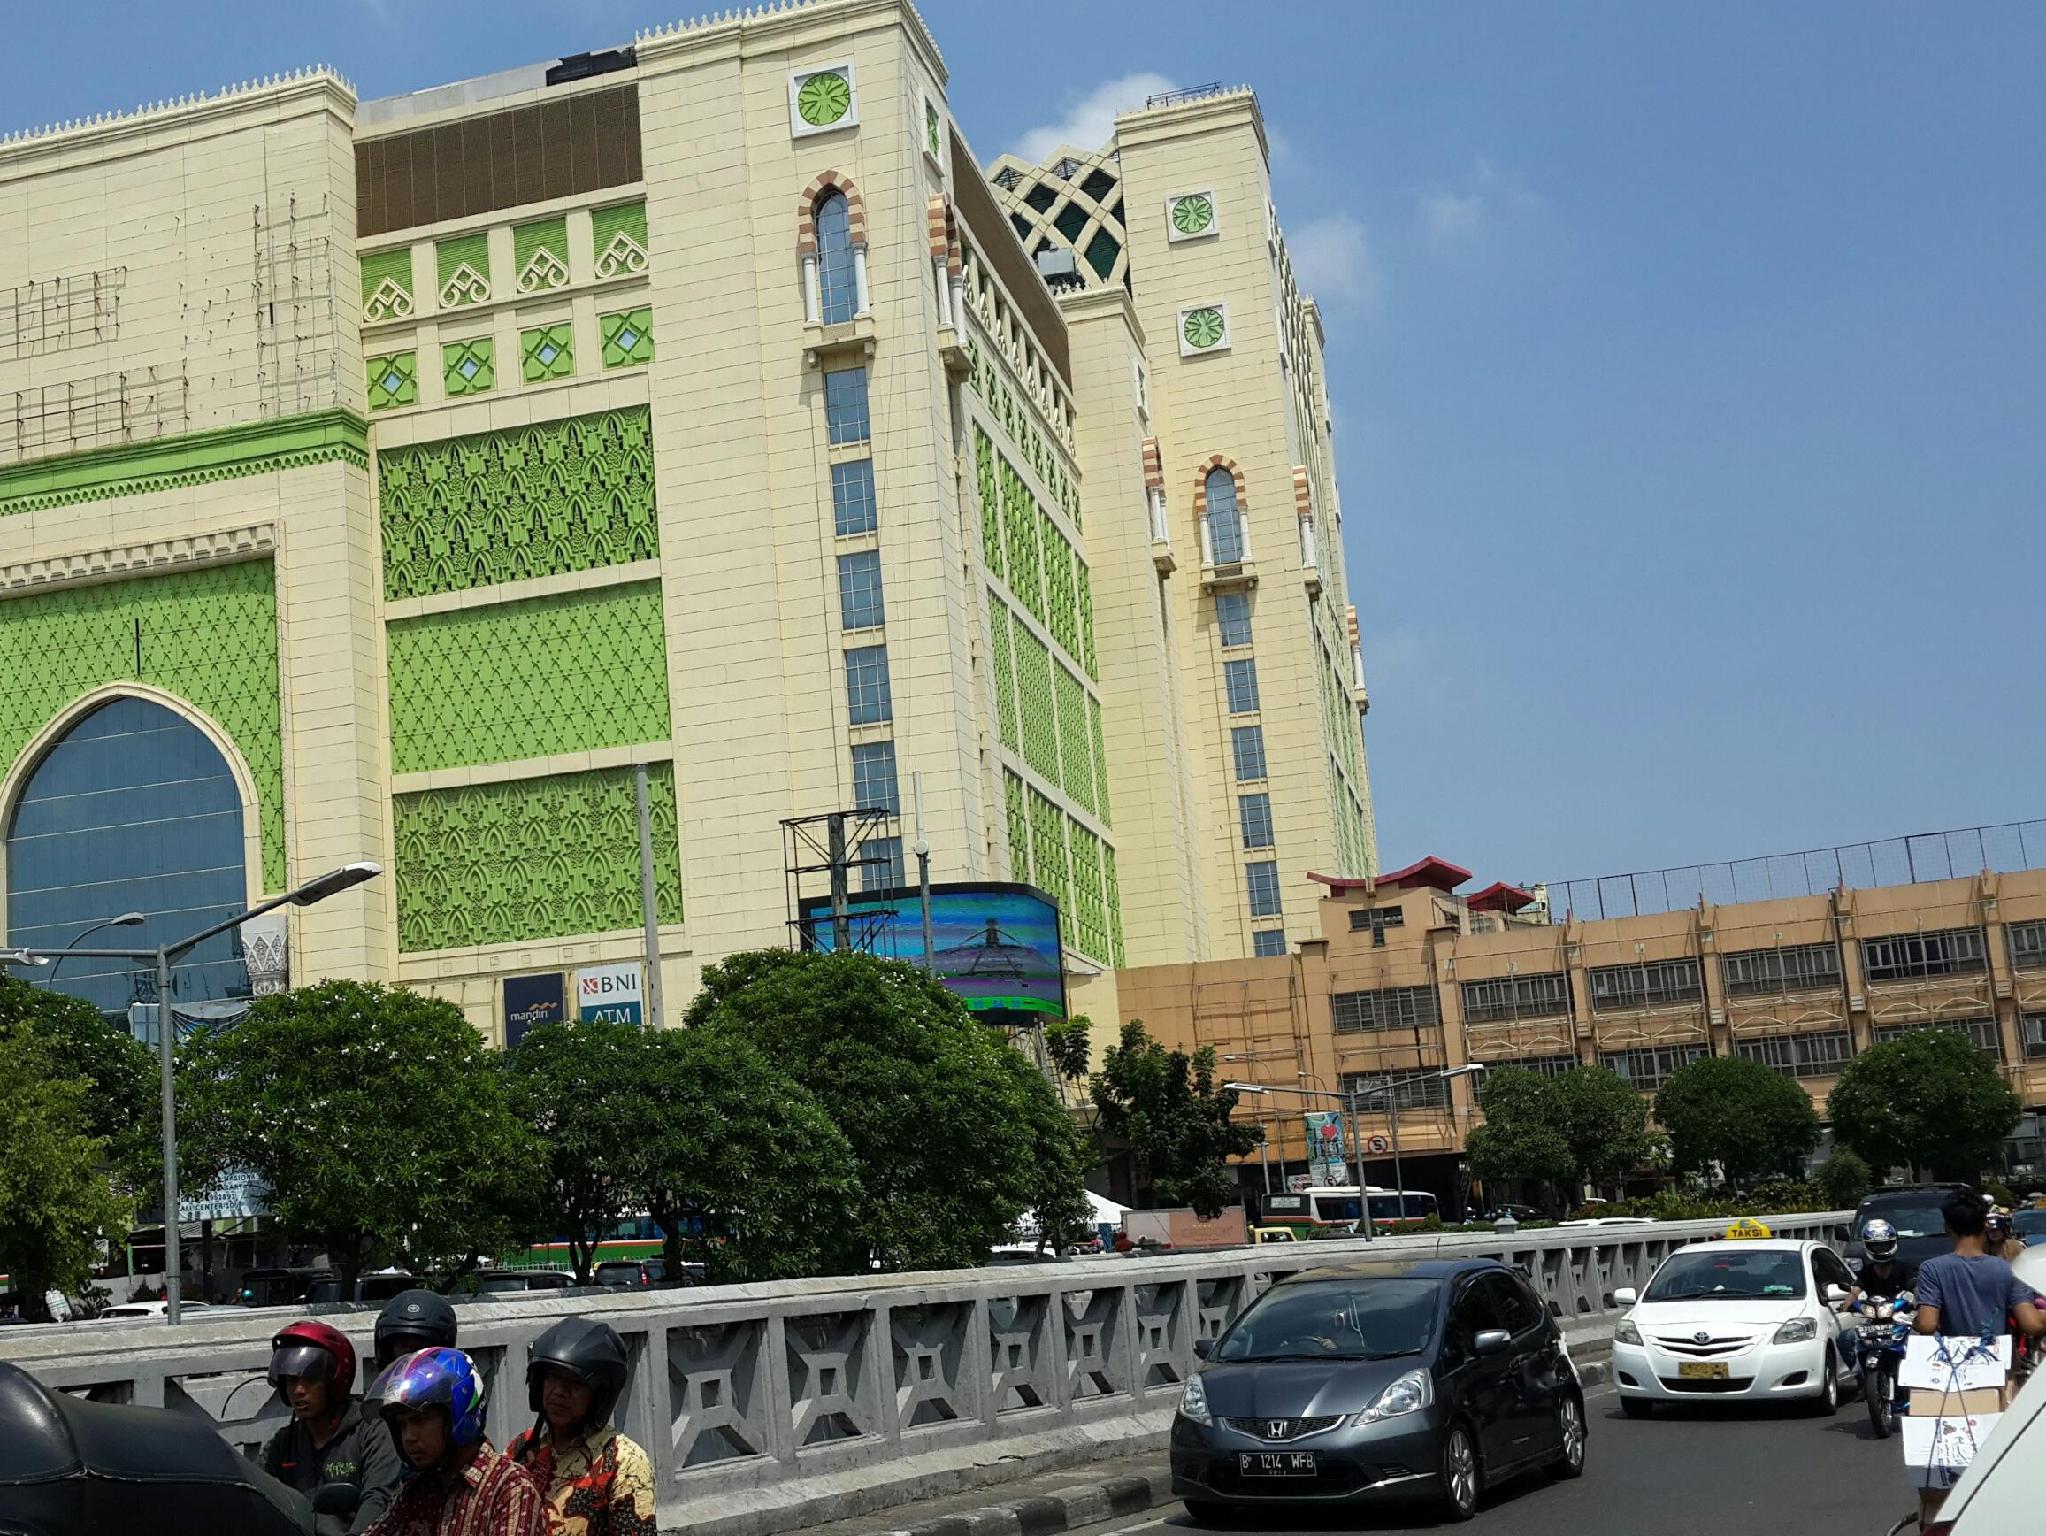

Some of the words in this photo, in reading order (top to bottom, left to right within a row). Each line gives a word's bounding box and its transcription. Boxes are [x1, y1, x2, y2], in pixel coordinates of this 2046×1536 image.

[602, 973, 636, 993] BNI
[594, 1008, 631, 1025] ATM
[1731, 1229, 1762, 1238] TAKSI
[1242, 1454, 1249, 1469] B
[1261, 1454, 1282, 1469] 1214
[1291, 1454, 1314, 1469] WFB
